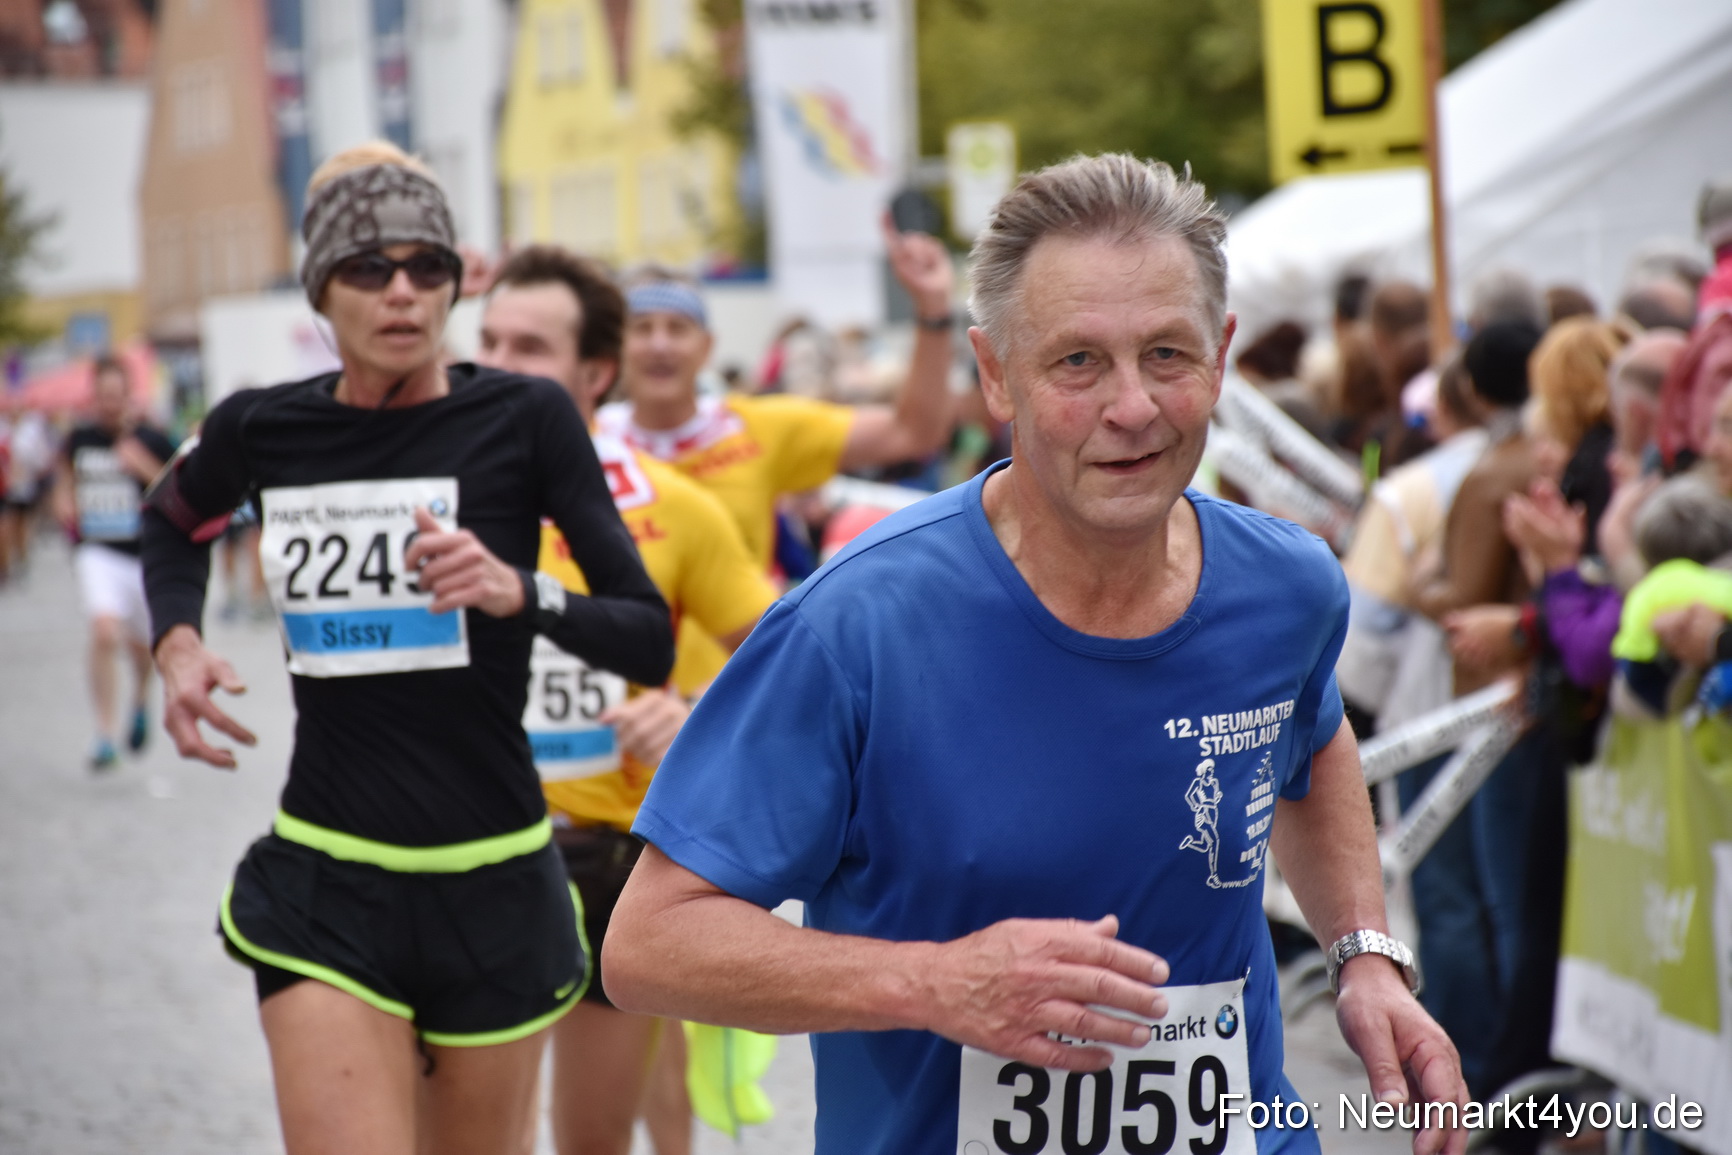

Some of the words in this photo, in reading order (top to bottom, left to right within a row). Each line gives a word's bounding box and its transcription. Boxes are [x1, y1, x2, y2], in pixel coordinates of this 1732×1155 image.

[1317, 2, 1394, 119] B
[321, 620, 393, 648] Sissy
[531, 669, 606, 722] 55
[1163, 717, 1200, 740] 12.
[1199, 722, 1282, 757] STADTLAUF
[992, 1055, 1230, 1155] 3059
